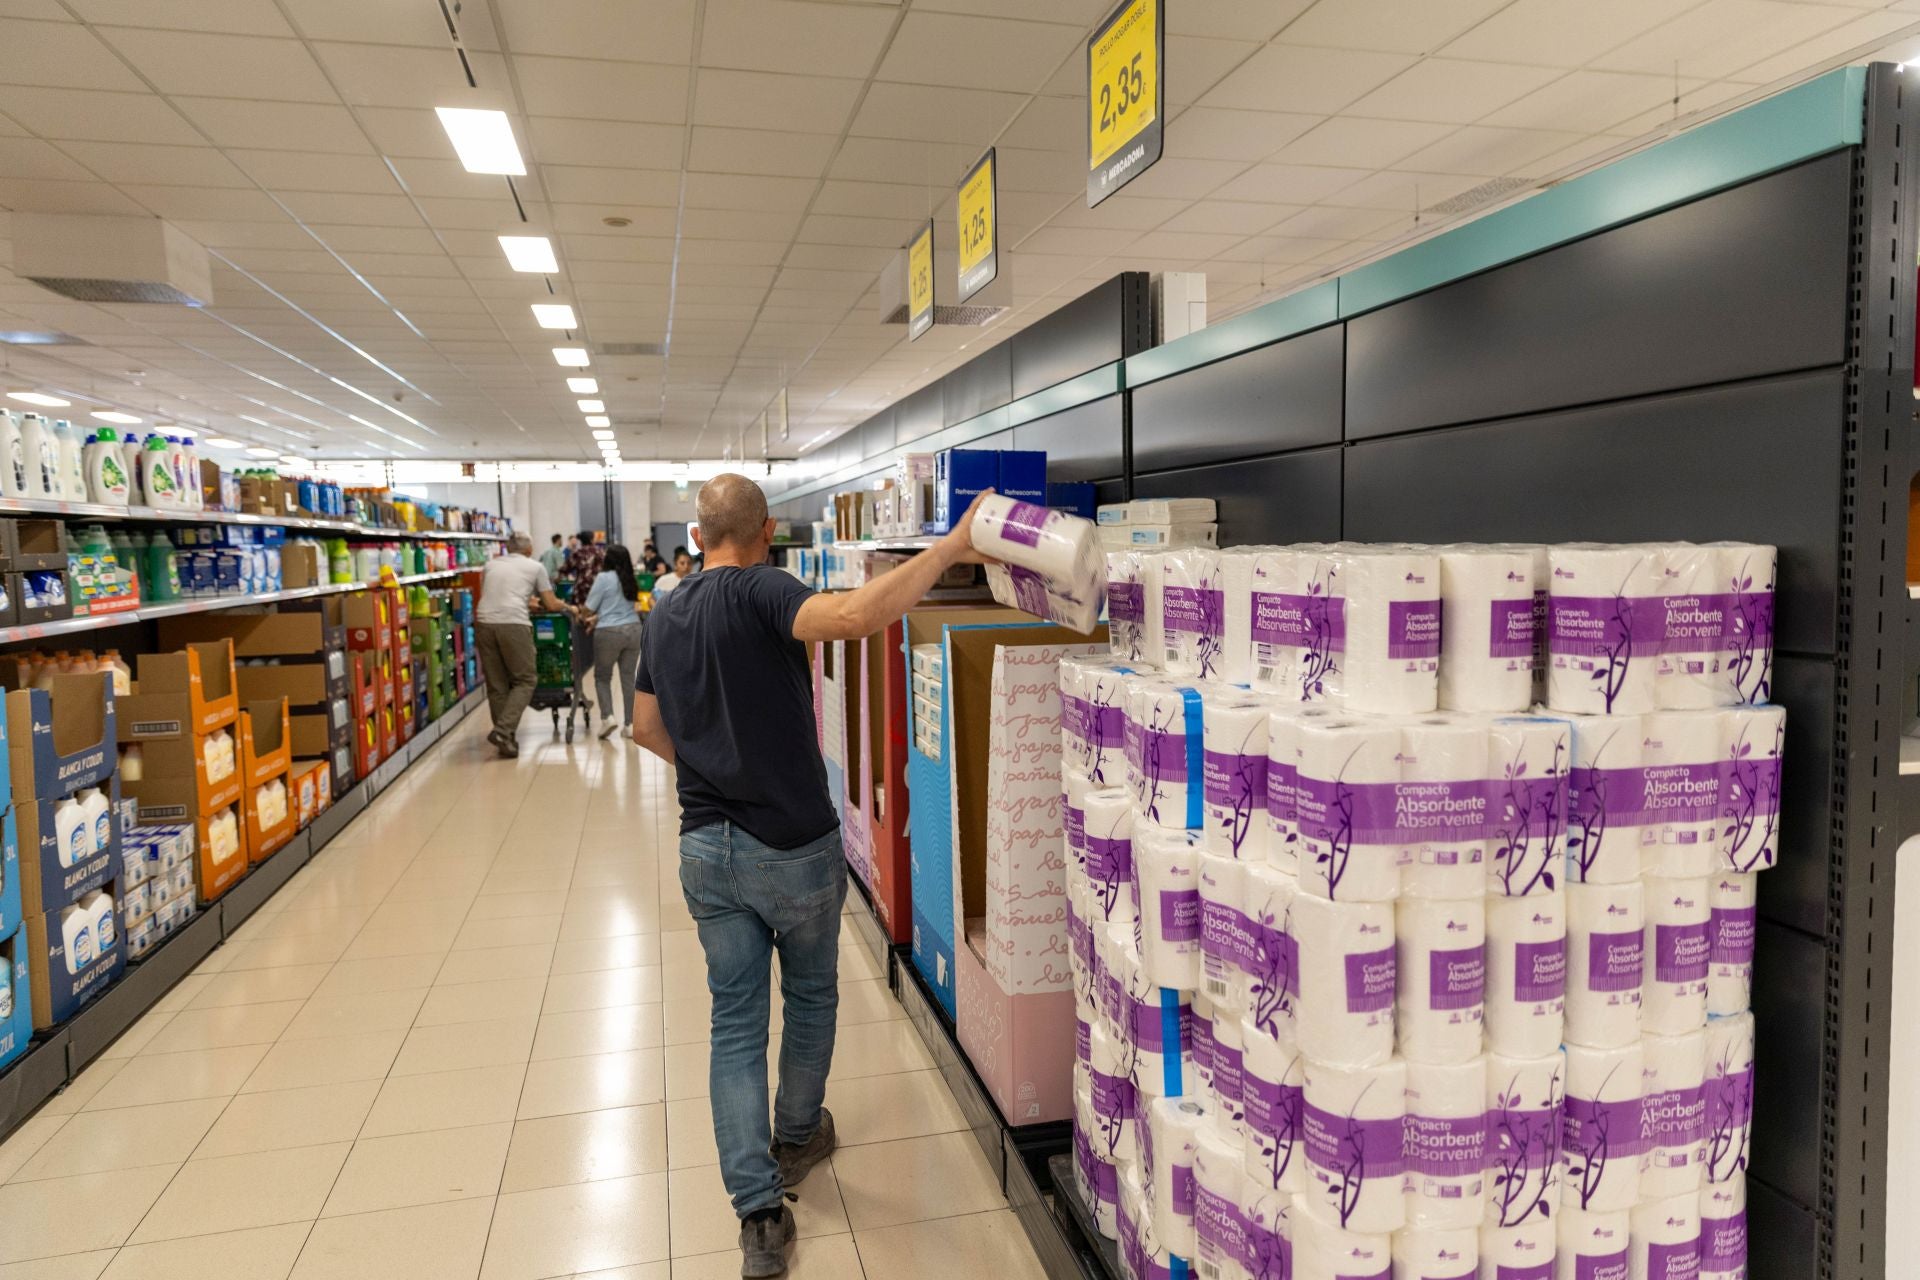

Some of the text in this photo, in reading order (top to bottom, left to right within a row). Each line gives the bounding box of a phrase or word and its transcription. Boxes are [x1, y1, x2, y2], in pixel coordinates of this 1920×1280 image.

[1100, 51, 1141, 132] 2,35
[1108, 144, 1145, 179] MERCADONA
[1164, 597, 1198, 610] Absorbente
[1257, 593, 1281, 604] Compacto
[1257, 604, 1301, 620] Absorbente
[1555, 608, 1589, 618] Compacto
[1665, 609, 1722, 624] Absorbente
[1257, 617, 1302, 633] Absorvente
[1556, 617, 1604, 629] Absorbente
[1665, 624, 1722, 638] Absorvente
[1556, 627, 1604, 639] Absorvente
[58, 762, 80, 780] BLANCA
[85, 752, 104, 768] COLOR
[1644, 767, 1690, 780] Compacto
[1395, 784, 1450, 797] Compacto
[1644, 779, 1718, 796] Absorbente
[1395, 796, 1486, 813] Absorbente
[1644, 794, 1717, 810] Absorvente
[1395, 812, 1484, 828] Absorvente
[64, 867, 87, 890] BLANCA
[92, 854, 110, 874] COLOR
[1202, 902, 1237, 919] Compacto
[1202, 912, 1255, 947] Absorbente
[17, 961, 26, 979] 3L
[72, 970, 96, 996] BLANCA
[1640, 1100, 1705, 1124] Absorbente
[1401, 1116, 1451, 1131] Compacto
[1640, 1114, 1705, 1138] Absorvente
[1402, 1127, 1485, 1147] Absorbente
